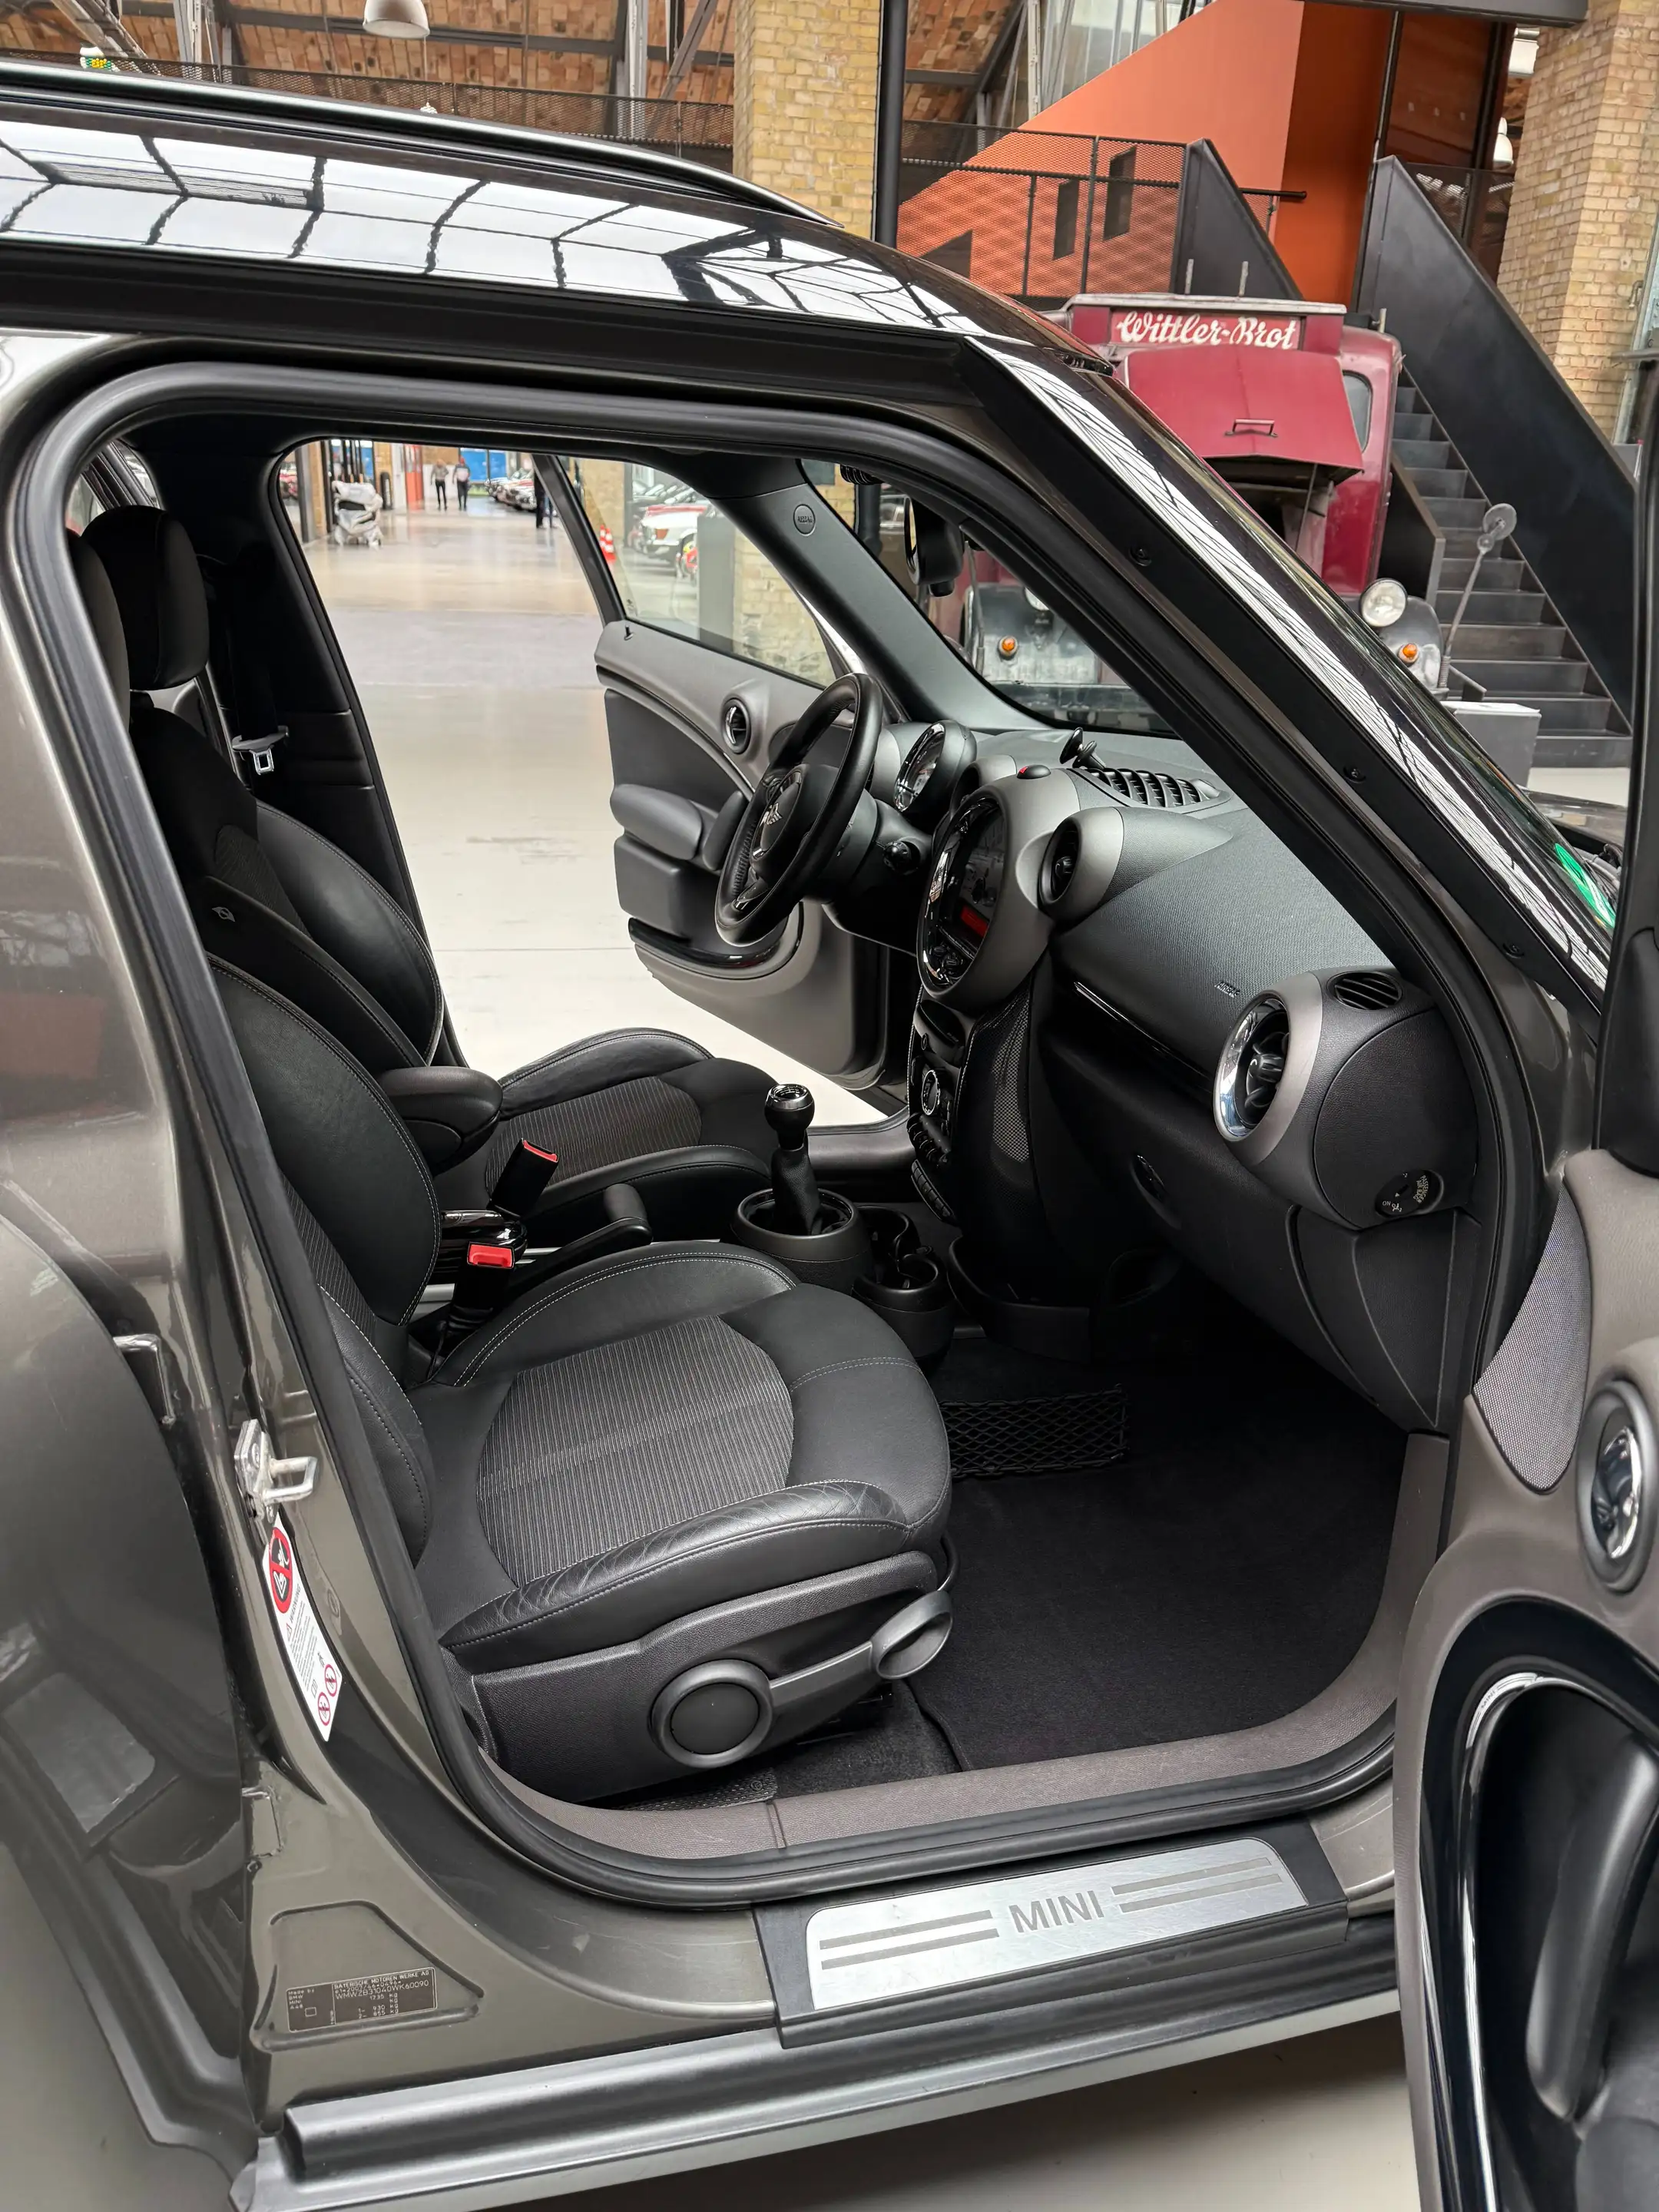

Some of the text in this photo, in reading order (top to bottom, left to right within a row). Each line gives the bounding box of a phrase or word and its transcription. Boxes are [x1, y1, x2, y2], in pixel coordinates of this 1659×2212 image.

[1116, 310, 1298, 350] Wittler-Brot
[1416, 1174, 1429, 1204] PASSENGER
[1008, 1890, 1104, 1933] MINI
[371, 1975, 398, 1984] MOTOREN
[399, 1971, 419, 1980] WERKE
